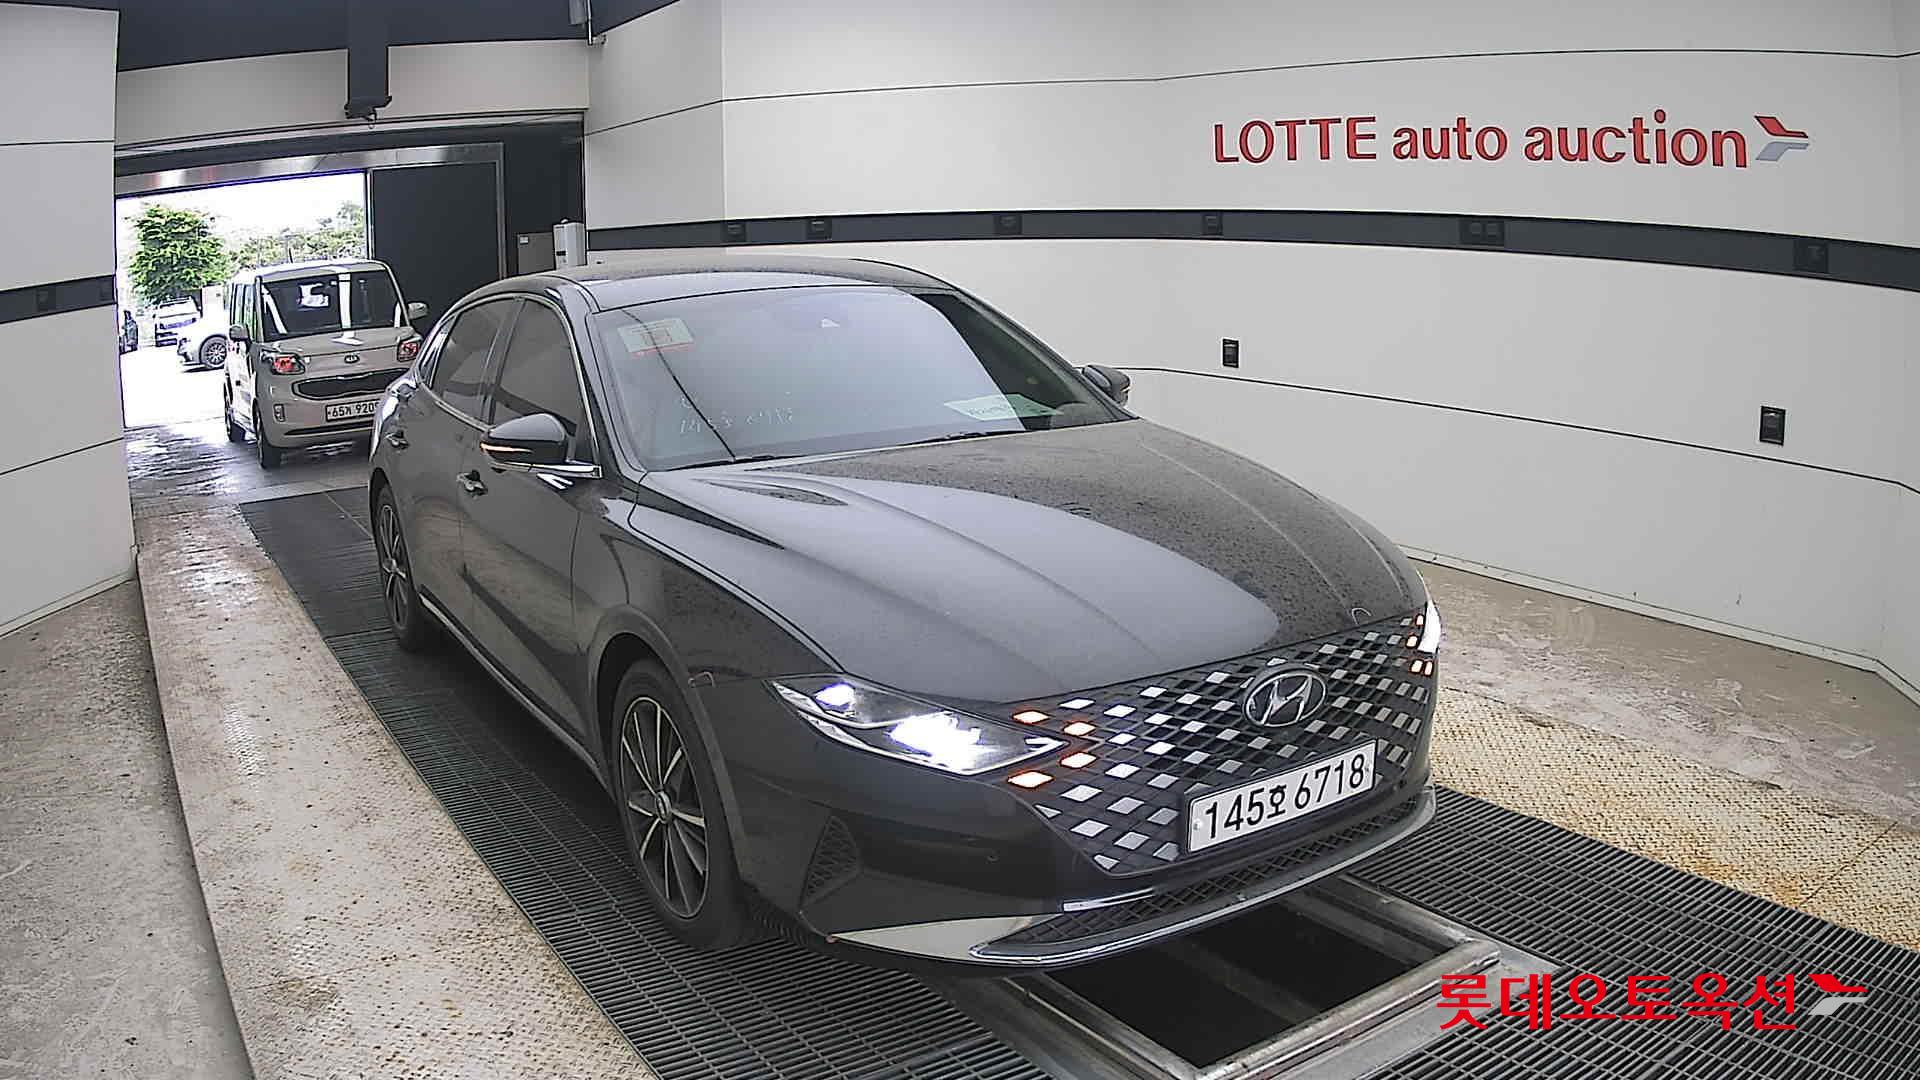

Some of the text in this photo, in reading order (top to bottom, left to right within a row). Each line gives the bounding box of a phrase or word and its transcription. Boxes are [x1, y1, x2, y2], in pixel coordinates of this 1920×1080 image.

[1213, 109, 1748, 169] LOTTE auto auction
[1205, 753, 1366, 840] 145호 6718
